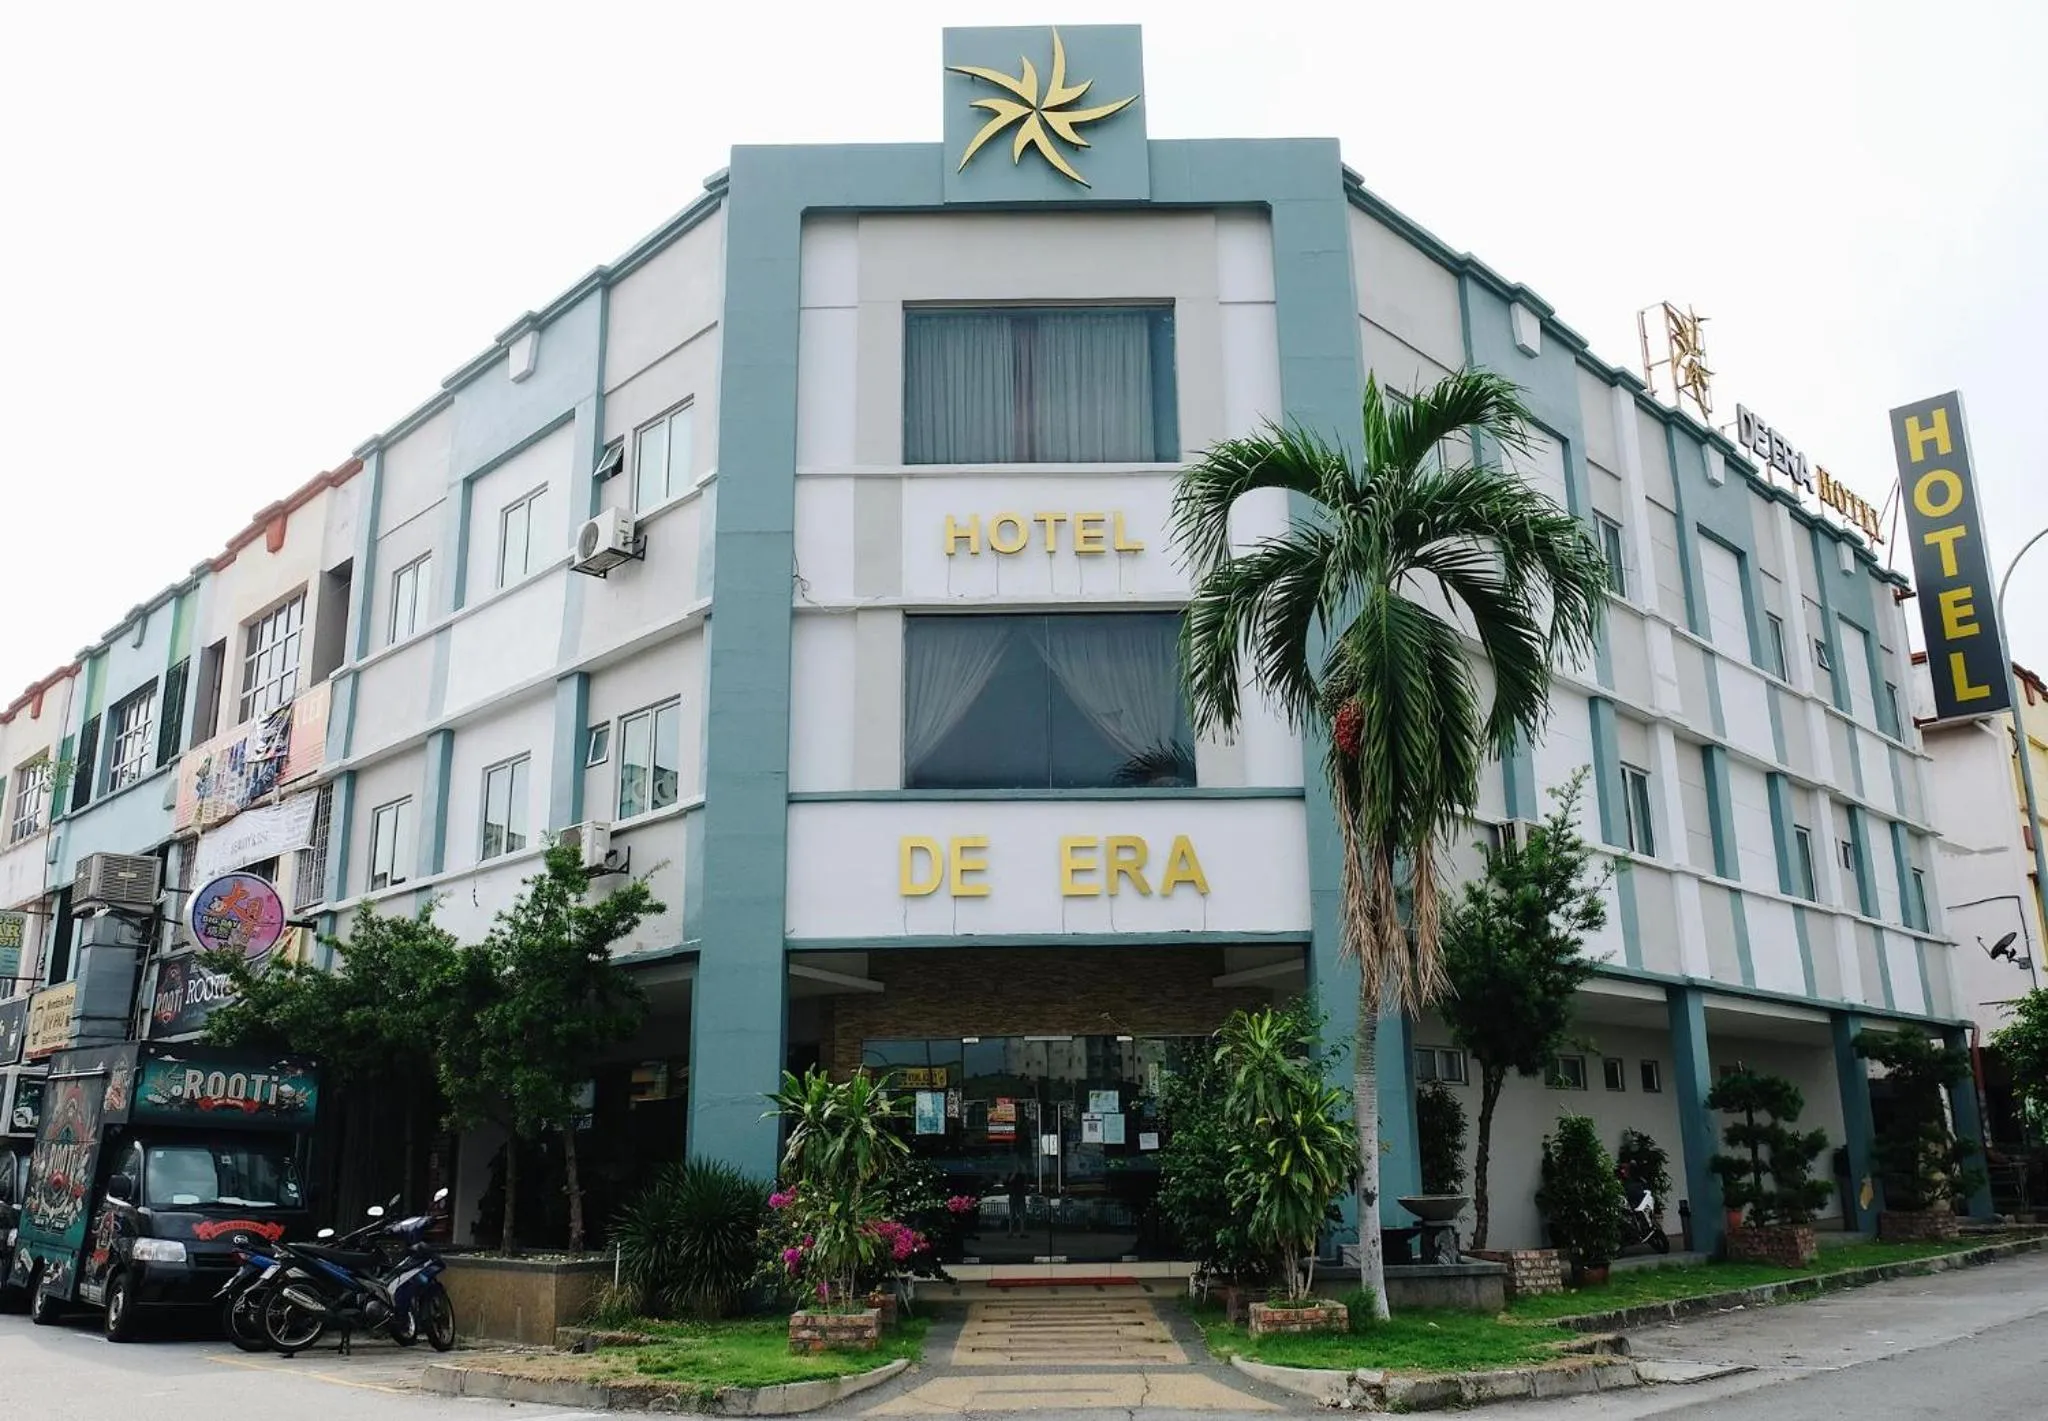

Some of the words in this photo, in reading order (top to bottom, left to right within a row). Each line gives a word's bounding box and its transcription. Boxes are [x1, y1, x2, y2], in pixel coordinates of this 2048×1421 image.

[945, 511, 1145, 556] HOTEL
[1905, 406, 1991, 703] HOTEL
[901, 835, 990, 897] DE
[1060, 835, 1210, 897] ERA
